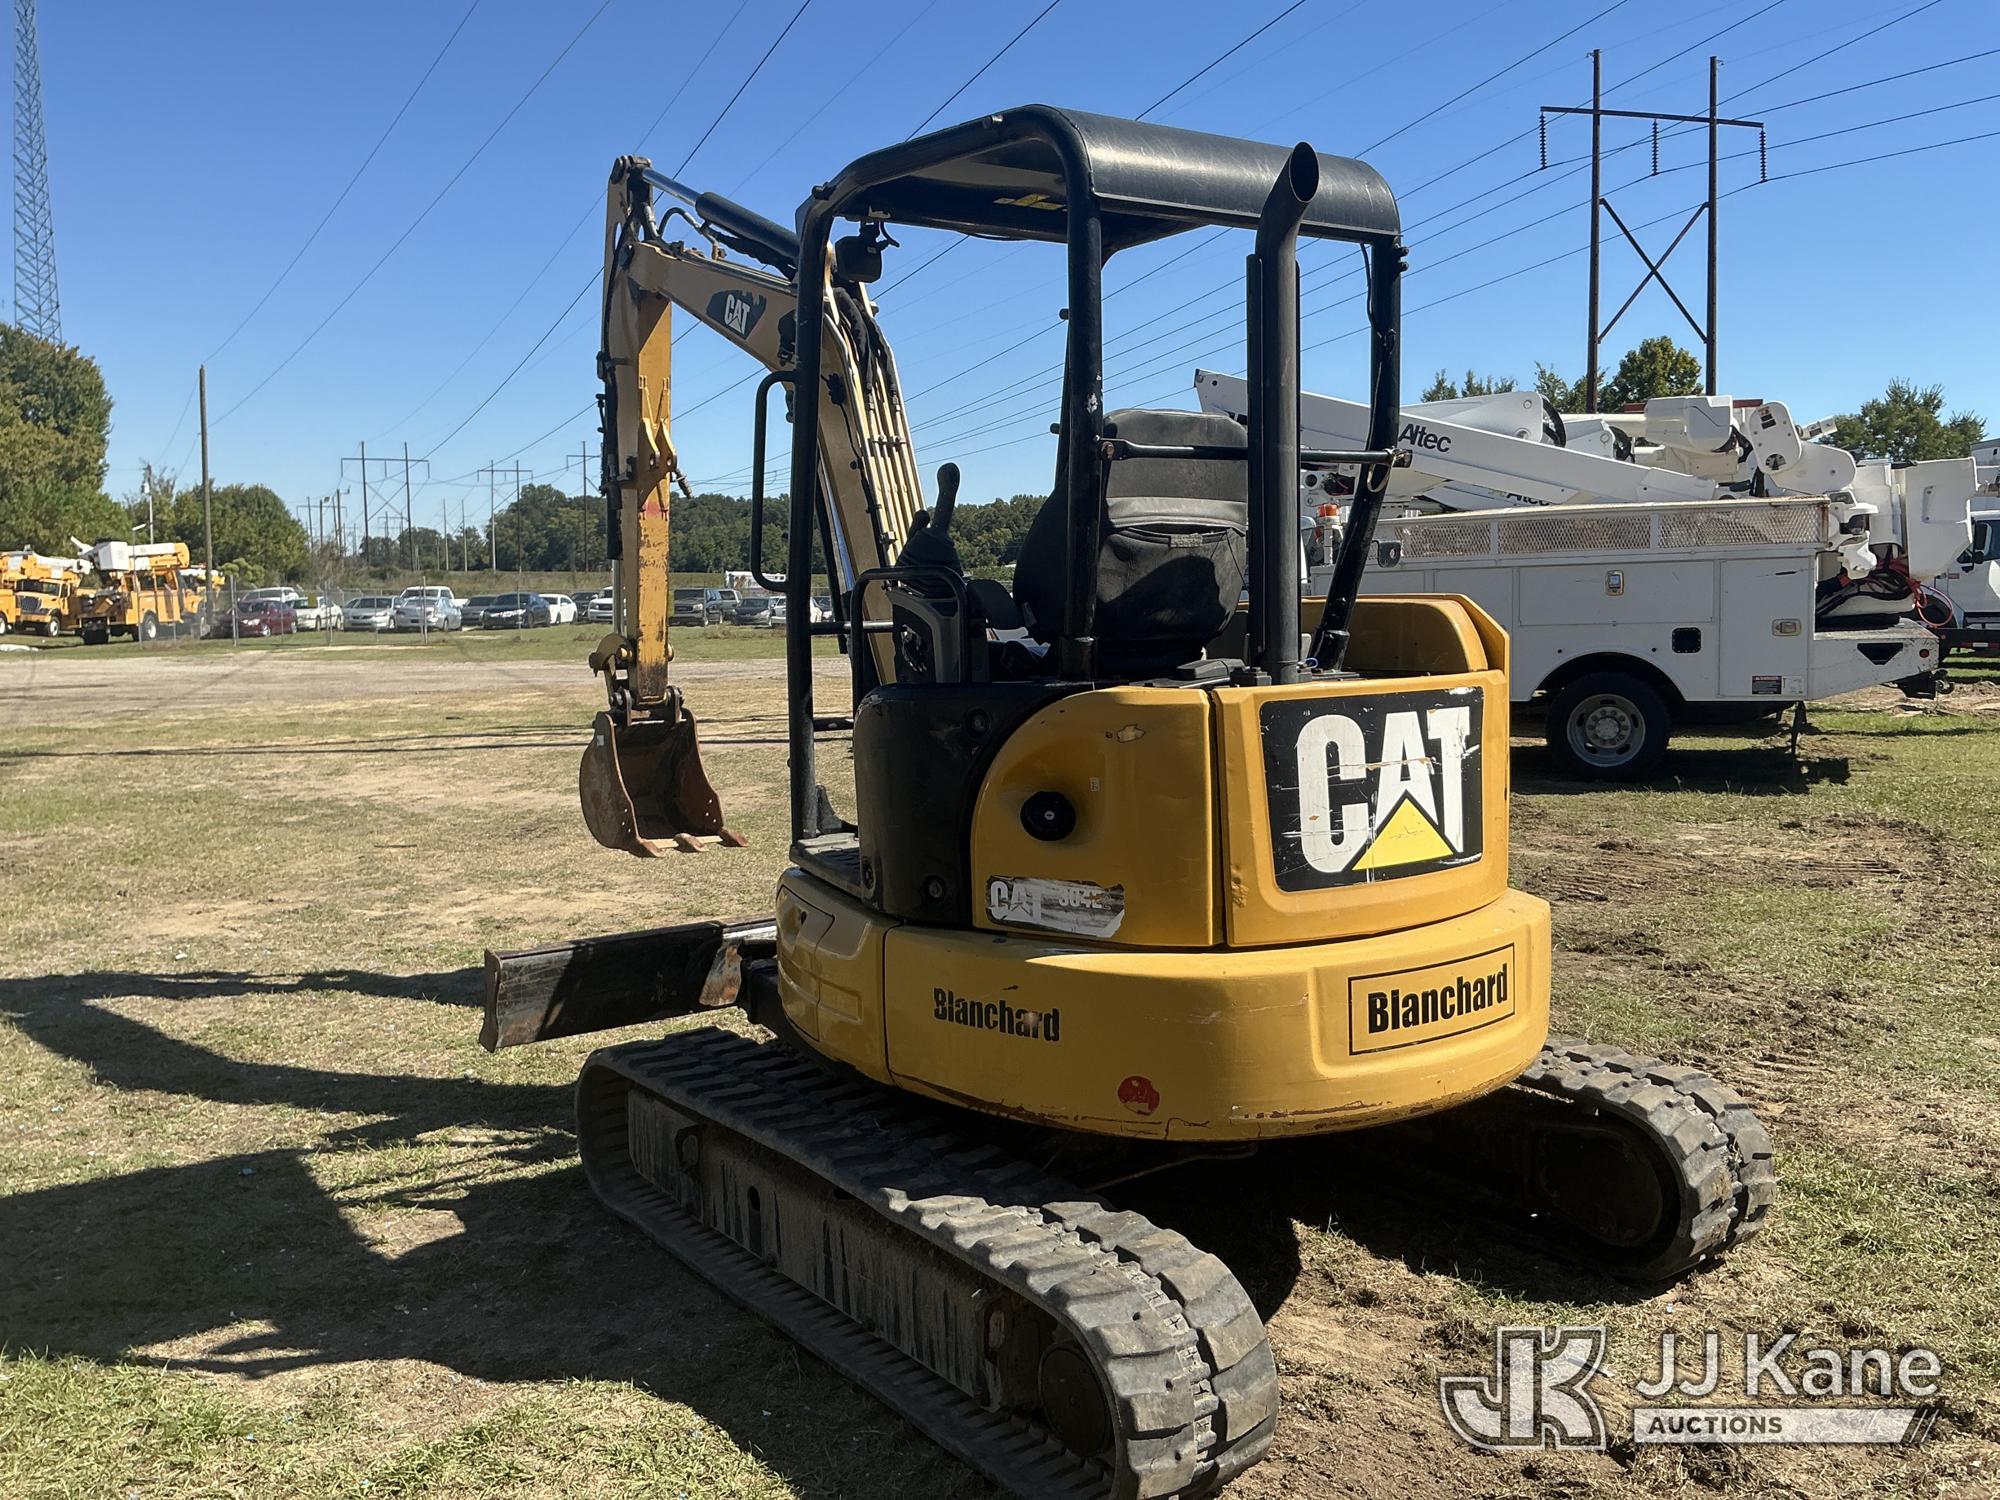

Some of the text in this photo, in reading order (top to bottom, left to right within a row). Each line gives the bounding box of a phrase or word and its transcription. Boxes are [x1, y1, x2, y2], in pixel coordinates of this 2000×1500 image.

[724, 294, 750, 335] CAT
[1398, 423, 1452, 452] Altec
[1297, 706, 1471, 873] CAT
[934, 988, 1060, 1042] Blanchard
[1368, 963, 1508, 1034] Blanchard
